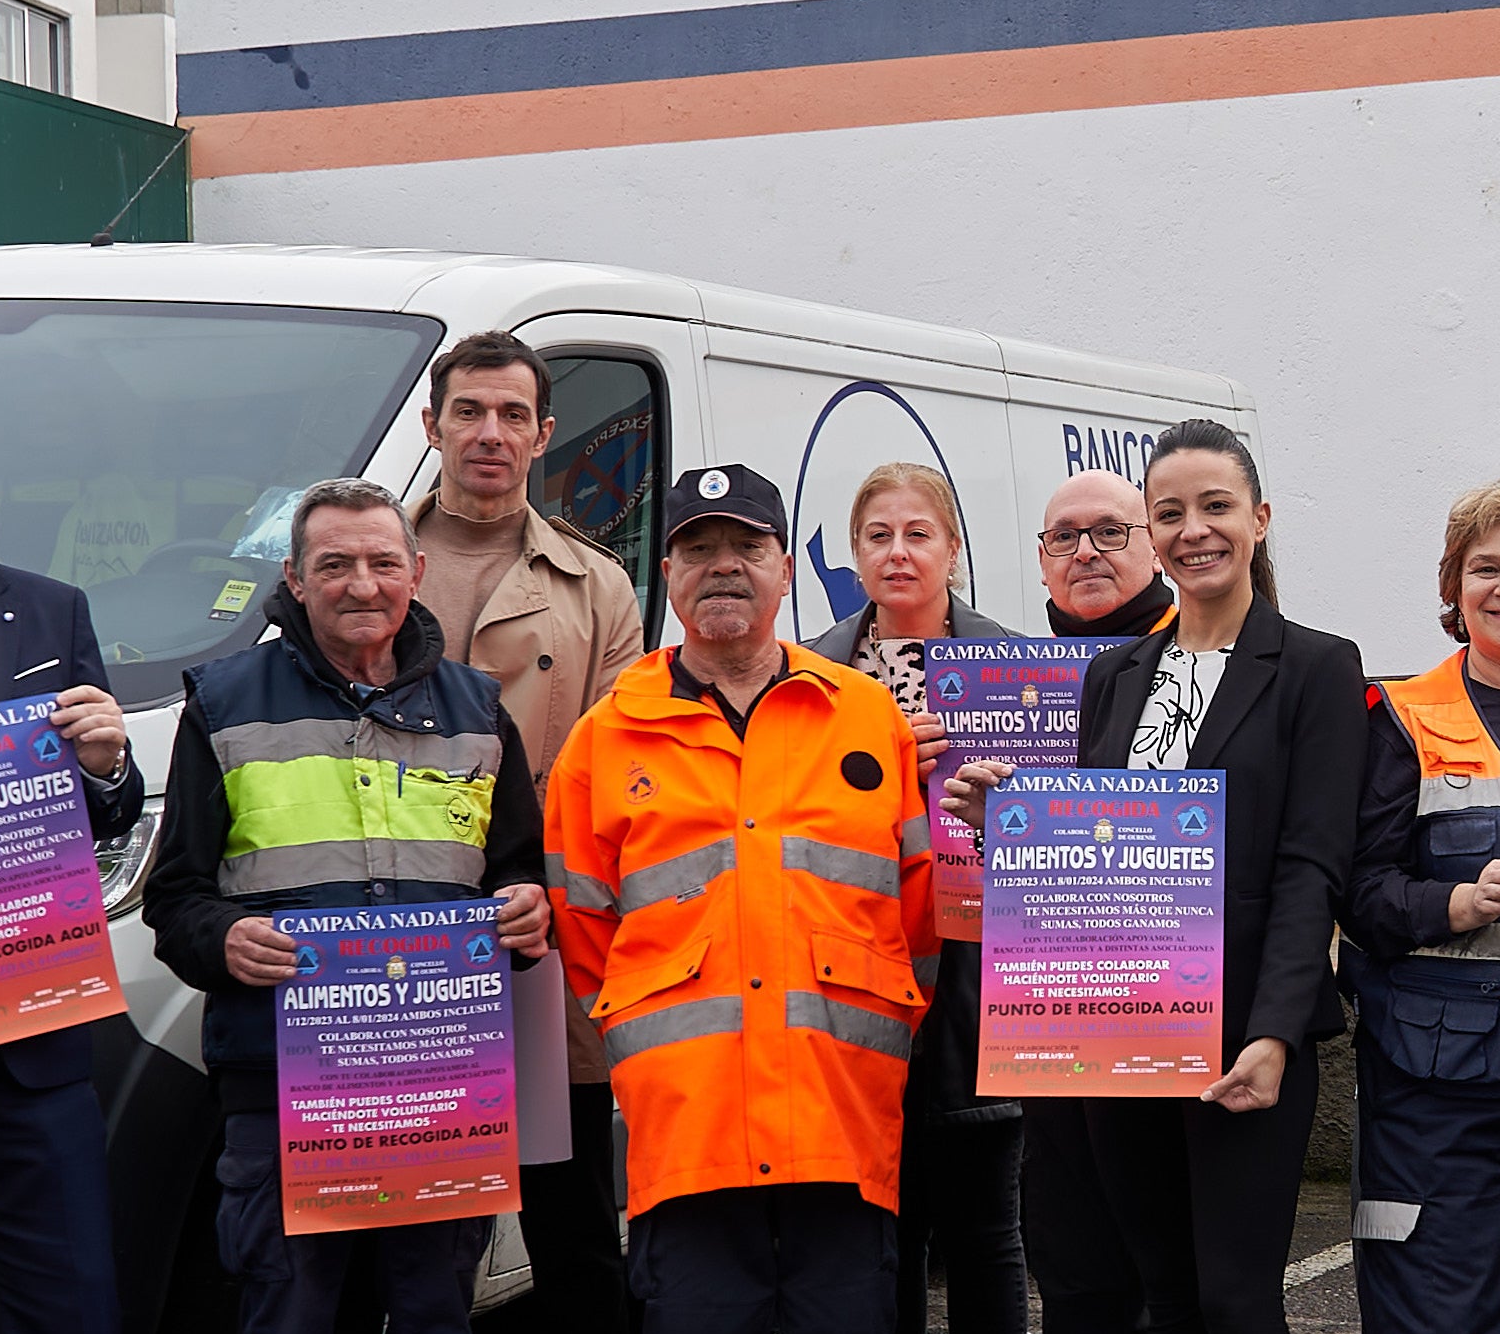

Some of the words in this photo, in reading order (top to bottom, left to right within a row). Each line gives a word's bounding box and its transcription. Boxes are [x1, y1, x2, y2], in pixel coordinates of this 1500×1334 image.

[930, 641, 1022, 660] CAMPAÑA
[1026, 644, 1091, 659] NADAL
[981, 666, 1080, 683] RECOGIDA
[1029, 710, 1040, 732] Y
[994, 772, 1095, 792] CAMPAÑA
[1100, 776, 1173, 793] NADAL
[1178, 777, 1219, 794] 2023
[1048, 799, 1160, 817] RECOGIDA
[991, 845, 1096, 870] ALIMENTOS
[1100, 846, 1115, 869] Y
[1118, 846, 1214, 870] JUGUETES
[279, 911, 385, 932] CAMPAÑA
[390, 908, 461, 929] NADAL
[339, 933, 450, 956] RECOGIDA
[283, 982, 390, 1010] ALIMENTOS
[395, 981, 408, 1005] Y
[412, 972, 501, 1004] JUGUETES
[989, 1003, 1045, 1016] PUNTO
[1051, 1003, 1071, 1015] DE
[1077, 1001, 1164, 1015] RECOGIDA
[1170, 1001, 1213, 1014] AQUI
